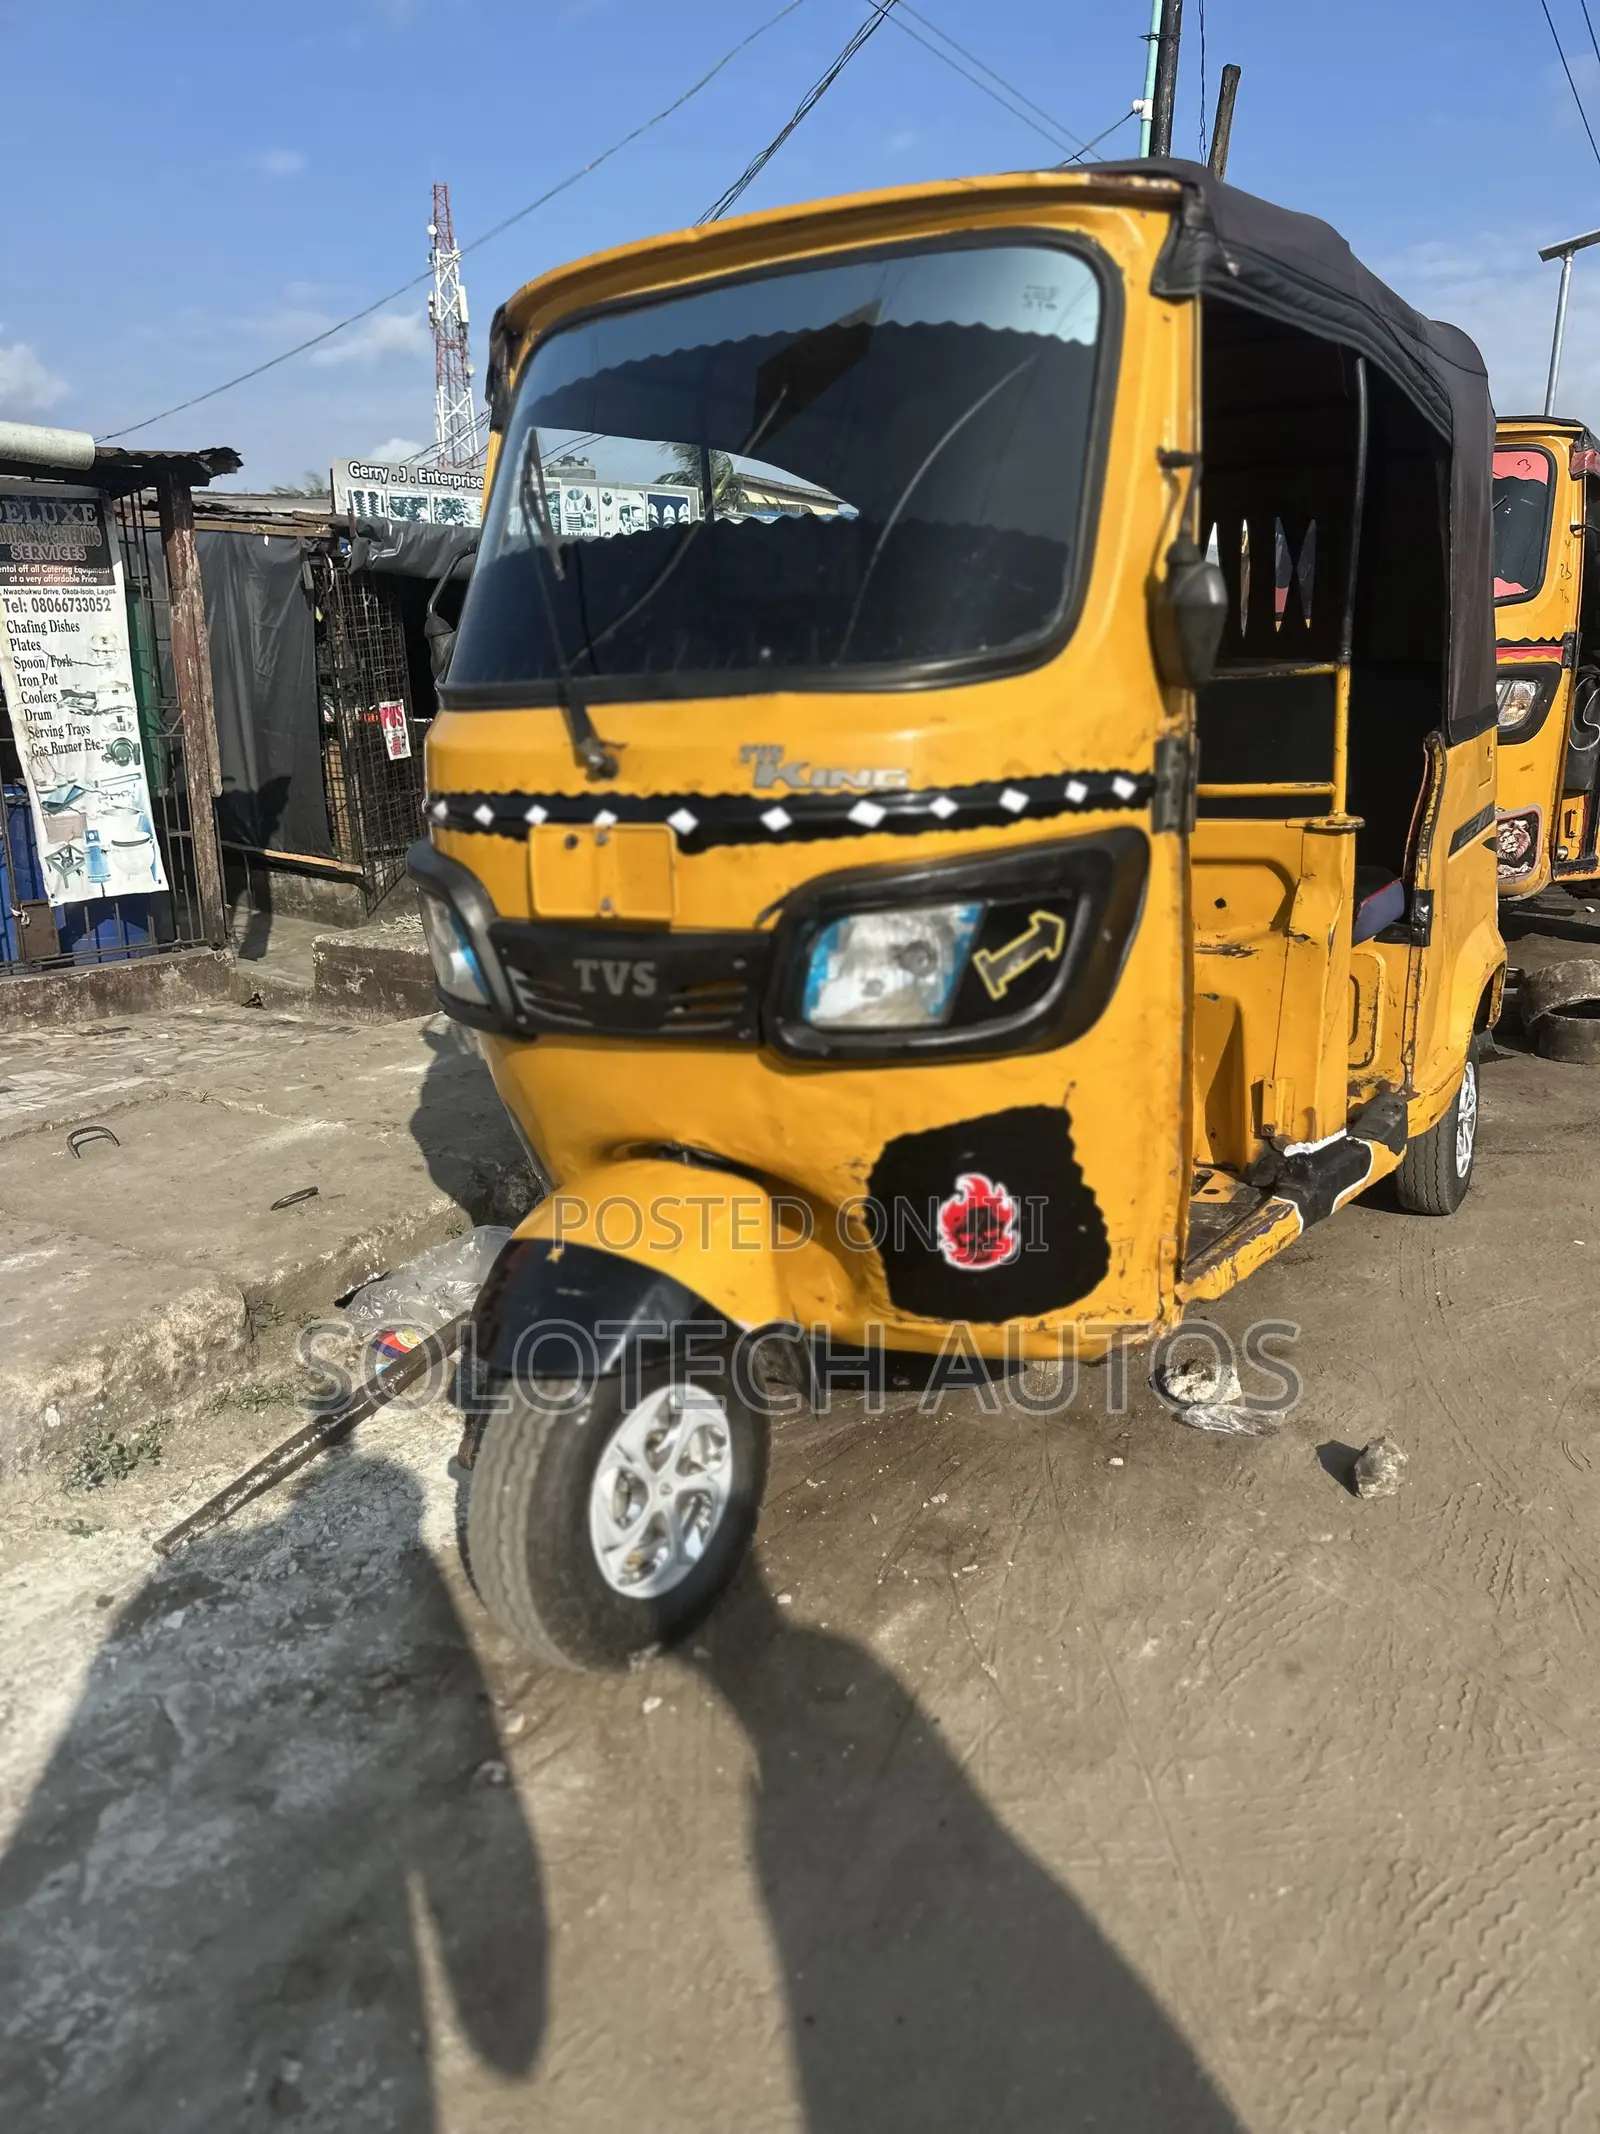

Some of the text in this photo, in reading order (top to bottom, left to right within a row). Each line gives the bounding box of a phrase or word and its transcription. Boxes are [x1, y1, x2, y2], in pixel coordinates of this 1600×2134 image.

[349, 461, 389, 484] Gerry
[417, 468, 484, 490] Enterprise
[0, 500, 98, 525] ELUXE
[48, 524, 103, 548] CATERING
[11, 544, 87, 562] SERVICES
[18, 564, 29, 573] off
[30, 564, 40, 573] all
[41, 565, 73, 575] Catering
[9, 575, 18, 583] at
[26, 576, 41, 585] very
[43, 574, 80, 583] affordable
[81, 575, 98, 583] Price
[3, 587, 42, 595] Nwachukwu
[3, 597, 112, 613] Tel: 08066733052
[6, 619, 80, 635] Chafing Dishes
[10, 638, 41, 651] Plates
[17, 672, 58, 687] Iron Pot
[21, 690, 58, 705] Coolers
[24, 708, 53, 722] Drum
[27, 723, 91, 740] Serving Trays
[31, 742, 49, 757] Gas
[50, 739, 82, 756] Burner
[572, 958, 658, 998] TVS
